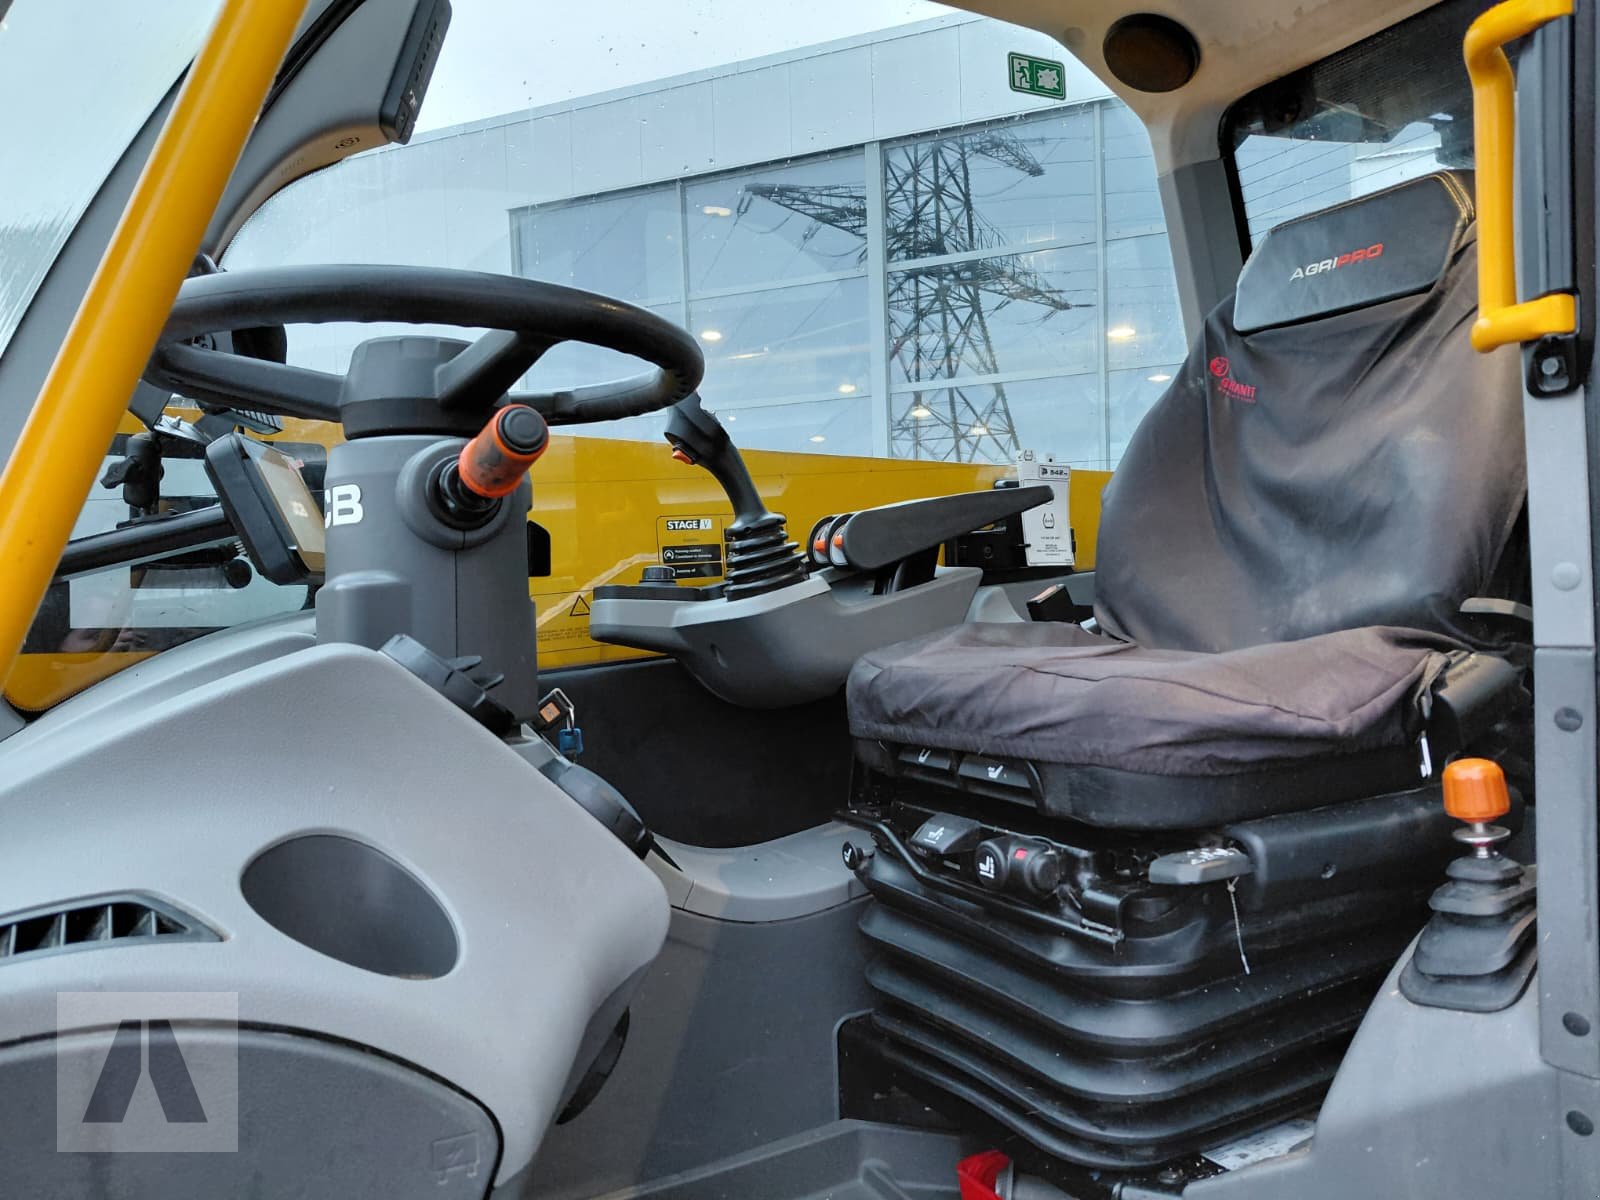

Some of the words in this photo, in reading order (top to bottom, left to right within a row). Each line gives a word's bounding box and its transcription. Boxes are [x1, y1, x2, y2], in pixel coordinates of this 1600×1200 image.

[1289, 243, 1384, 282] AGRIPRO
[324, 484, 364, 529] B
[667, 520, 699, 530] STAGE
